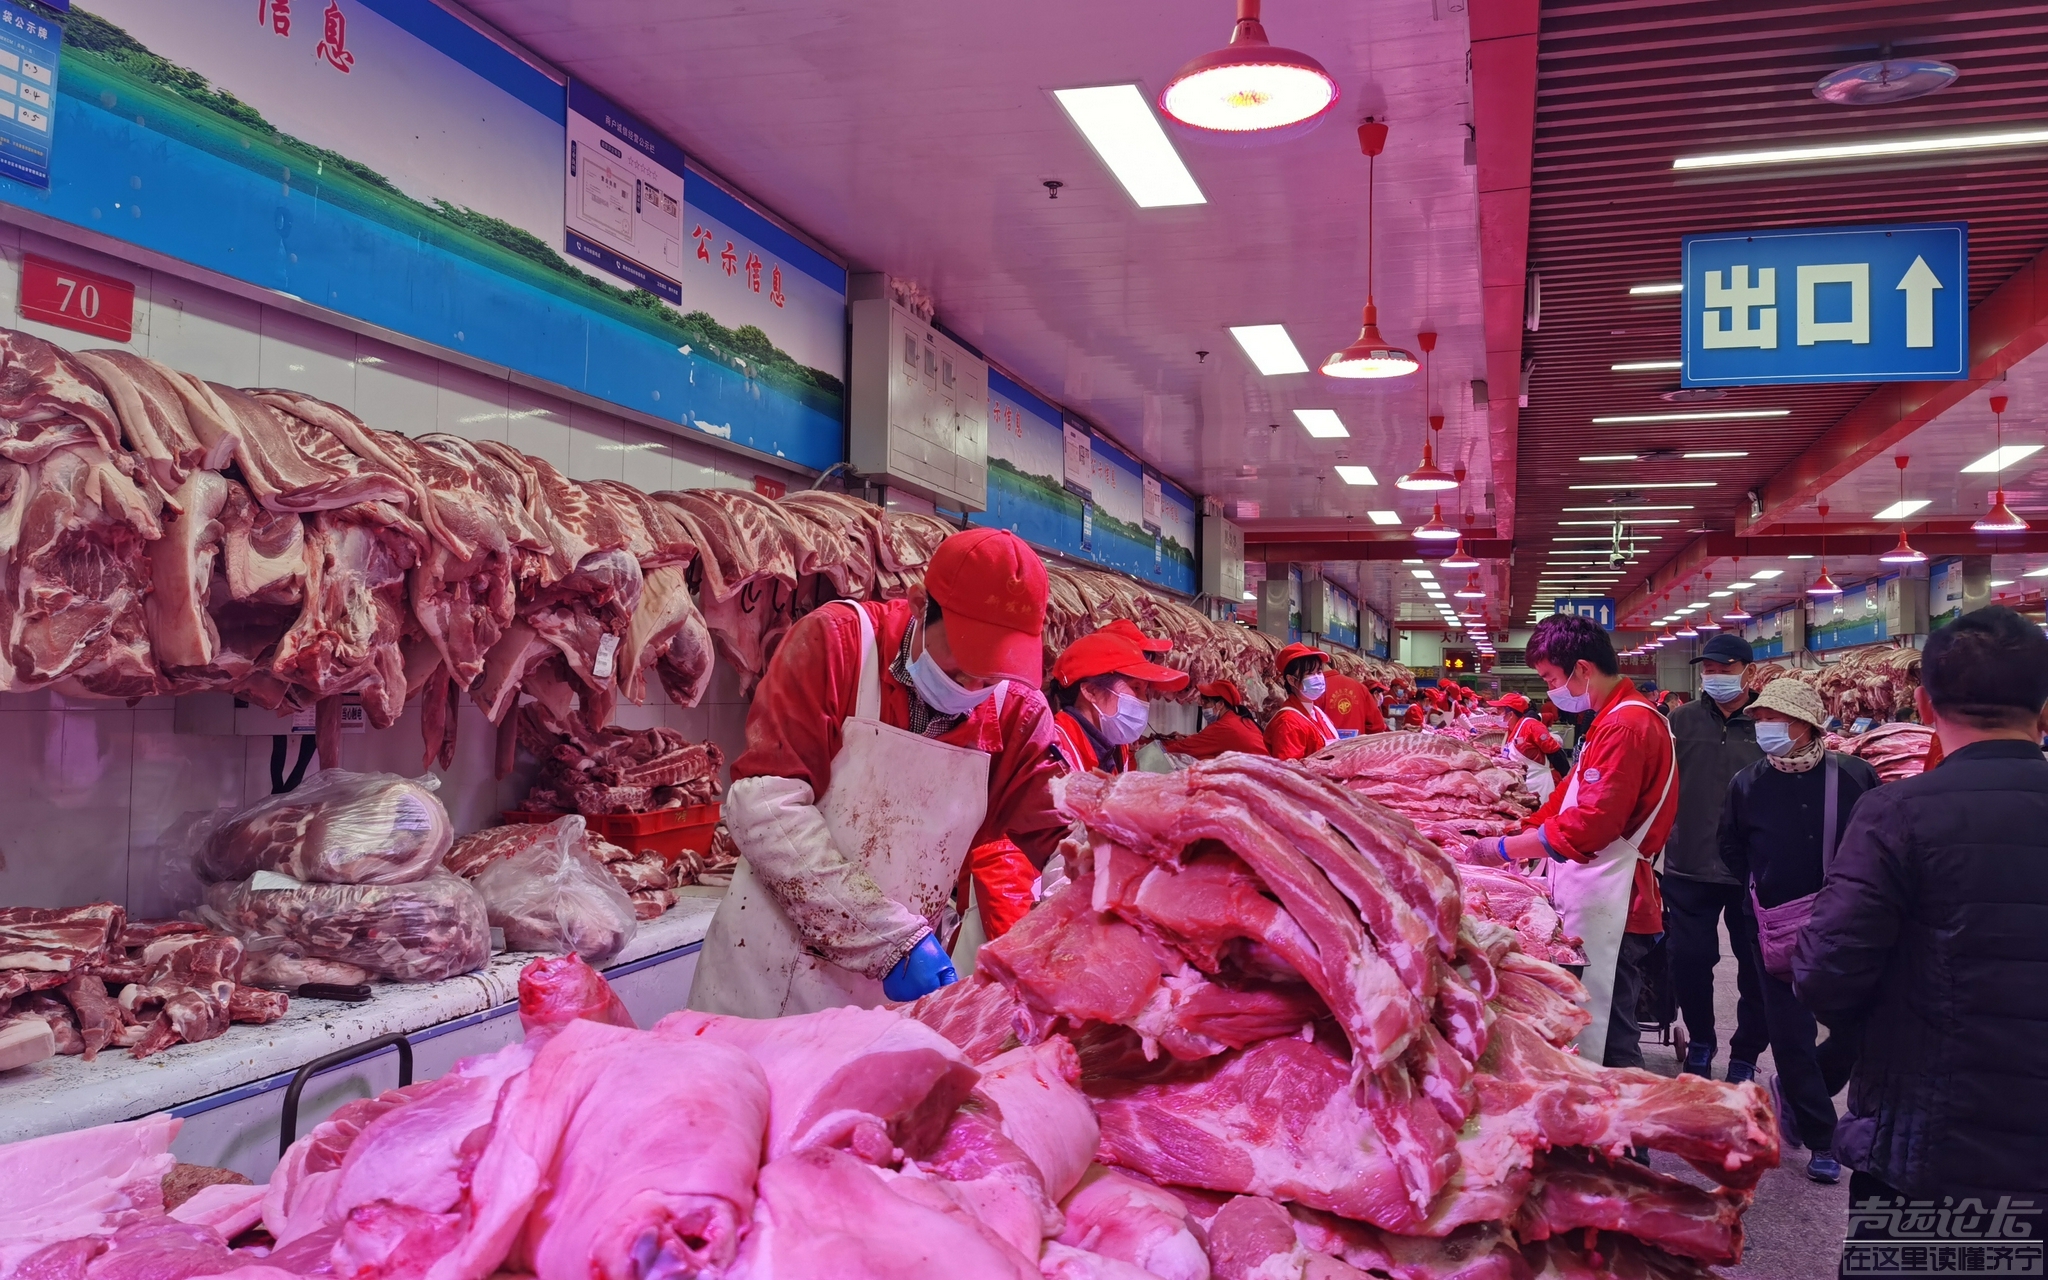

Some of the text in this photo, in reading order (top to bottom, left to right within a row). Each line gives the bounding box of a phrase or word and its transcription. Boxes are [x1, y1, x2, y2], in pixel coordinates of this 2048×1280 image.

[24, 88, 41, 101] 0.4
[23, 111, 40, 122] 0.5
[692, 224, 785, 309] 公示信息
[55, 276, 101, 319] 70
[1703, 263, 1870, 350] 出口
